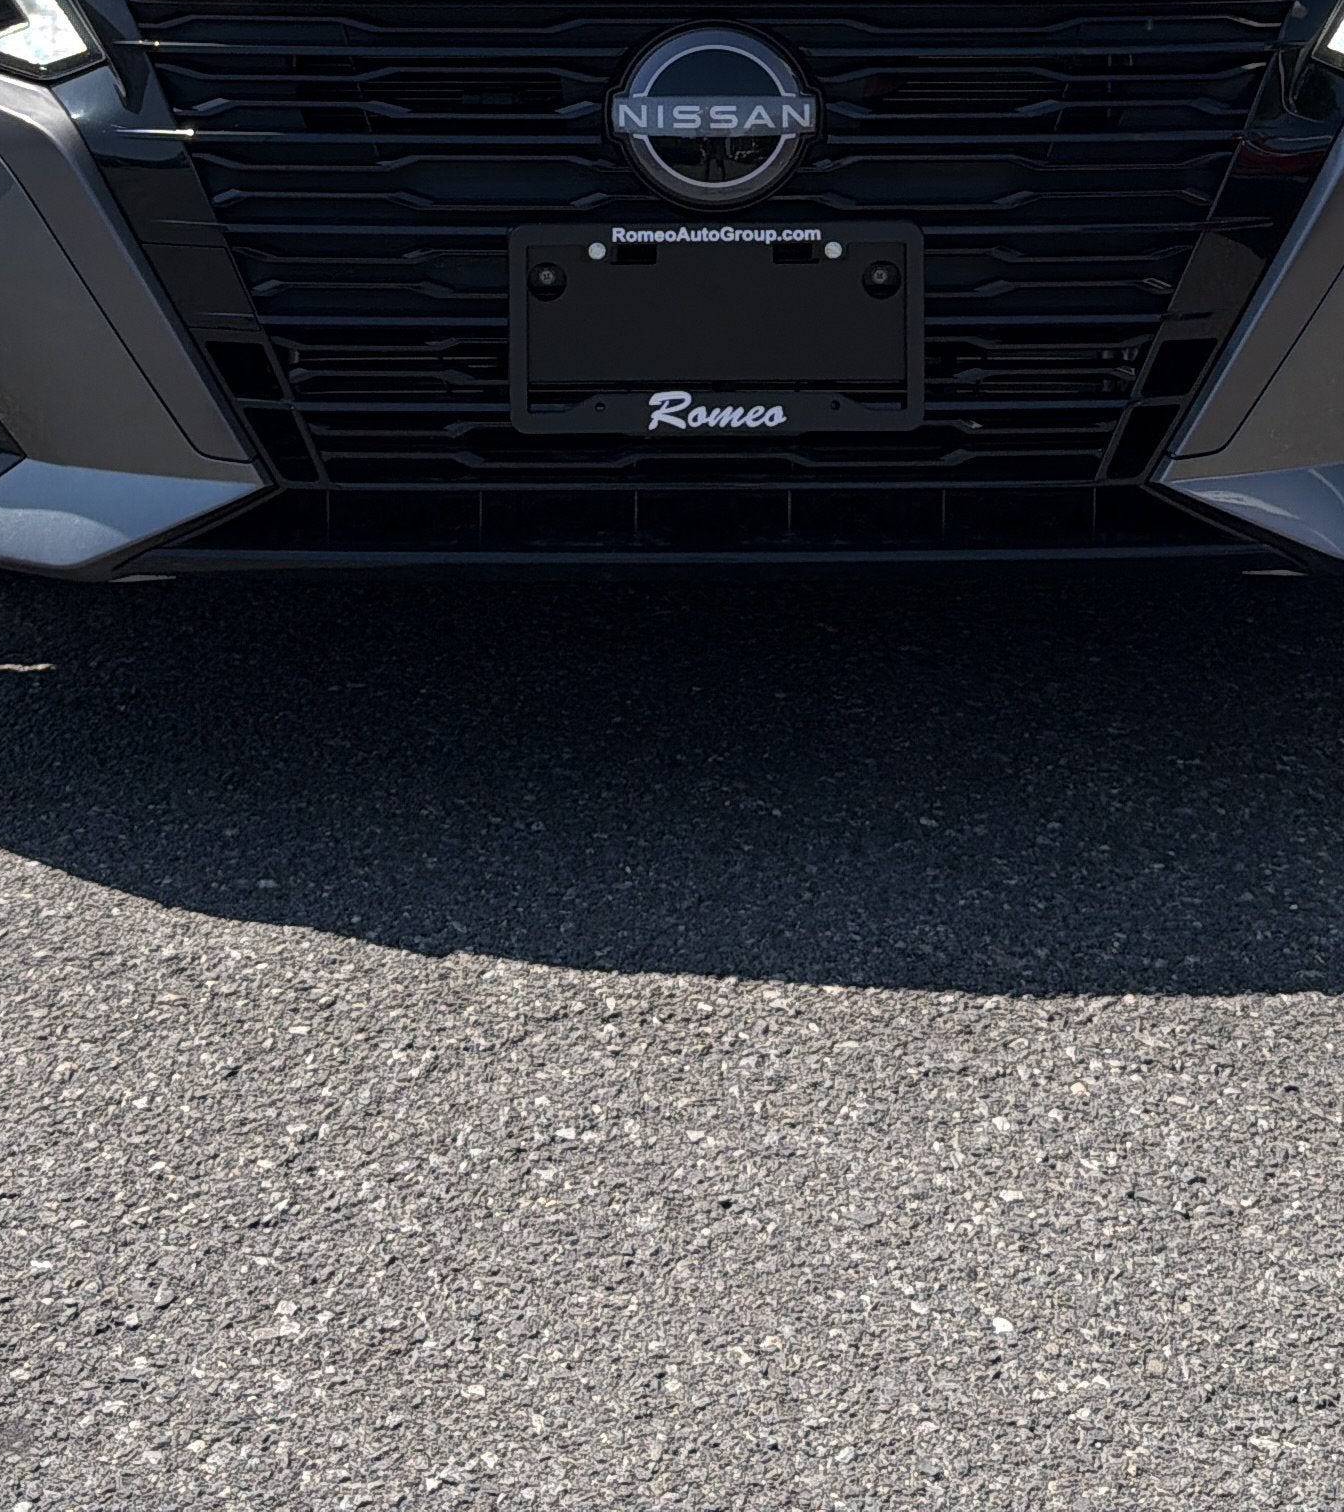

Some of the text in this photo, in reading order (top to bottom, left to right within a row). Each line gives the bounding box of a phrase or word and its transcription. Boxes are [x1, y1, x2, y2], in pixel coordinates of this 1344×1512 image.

[618, 103, 811, 129] NISSAN
[611, 226, 822, 244] RomeoAutoGroup.com
[648, 390, 788, 431] Romeo
